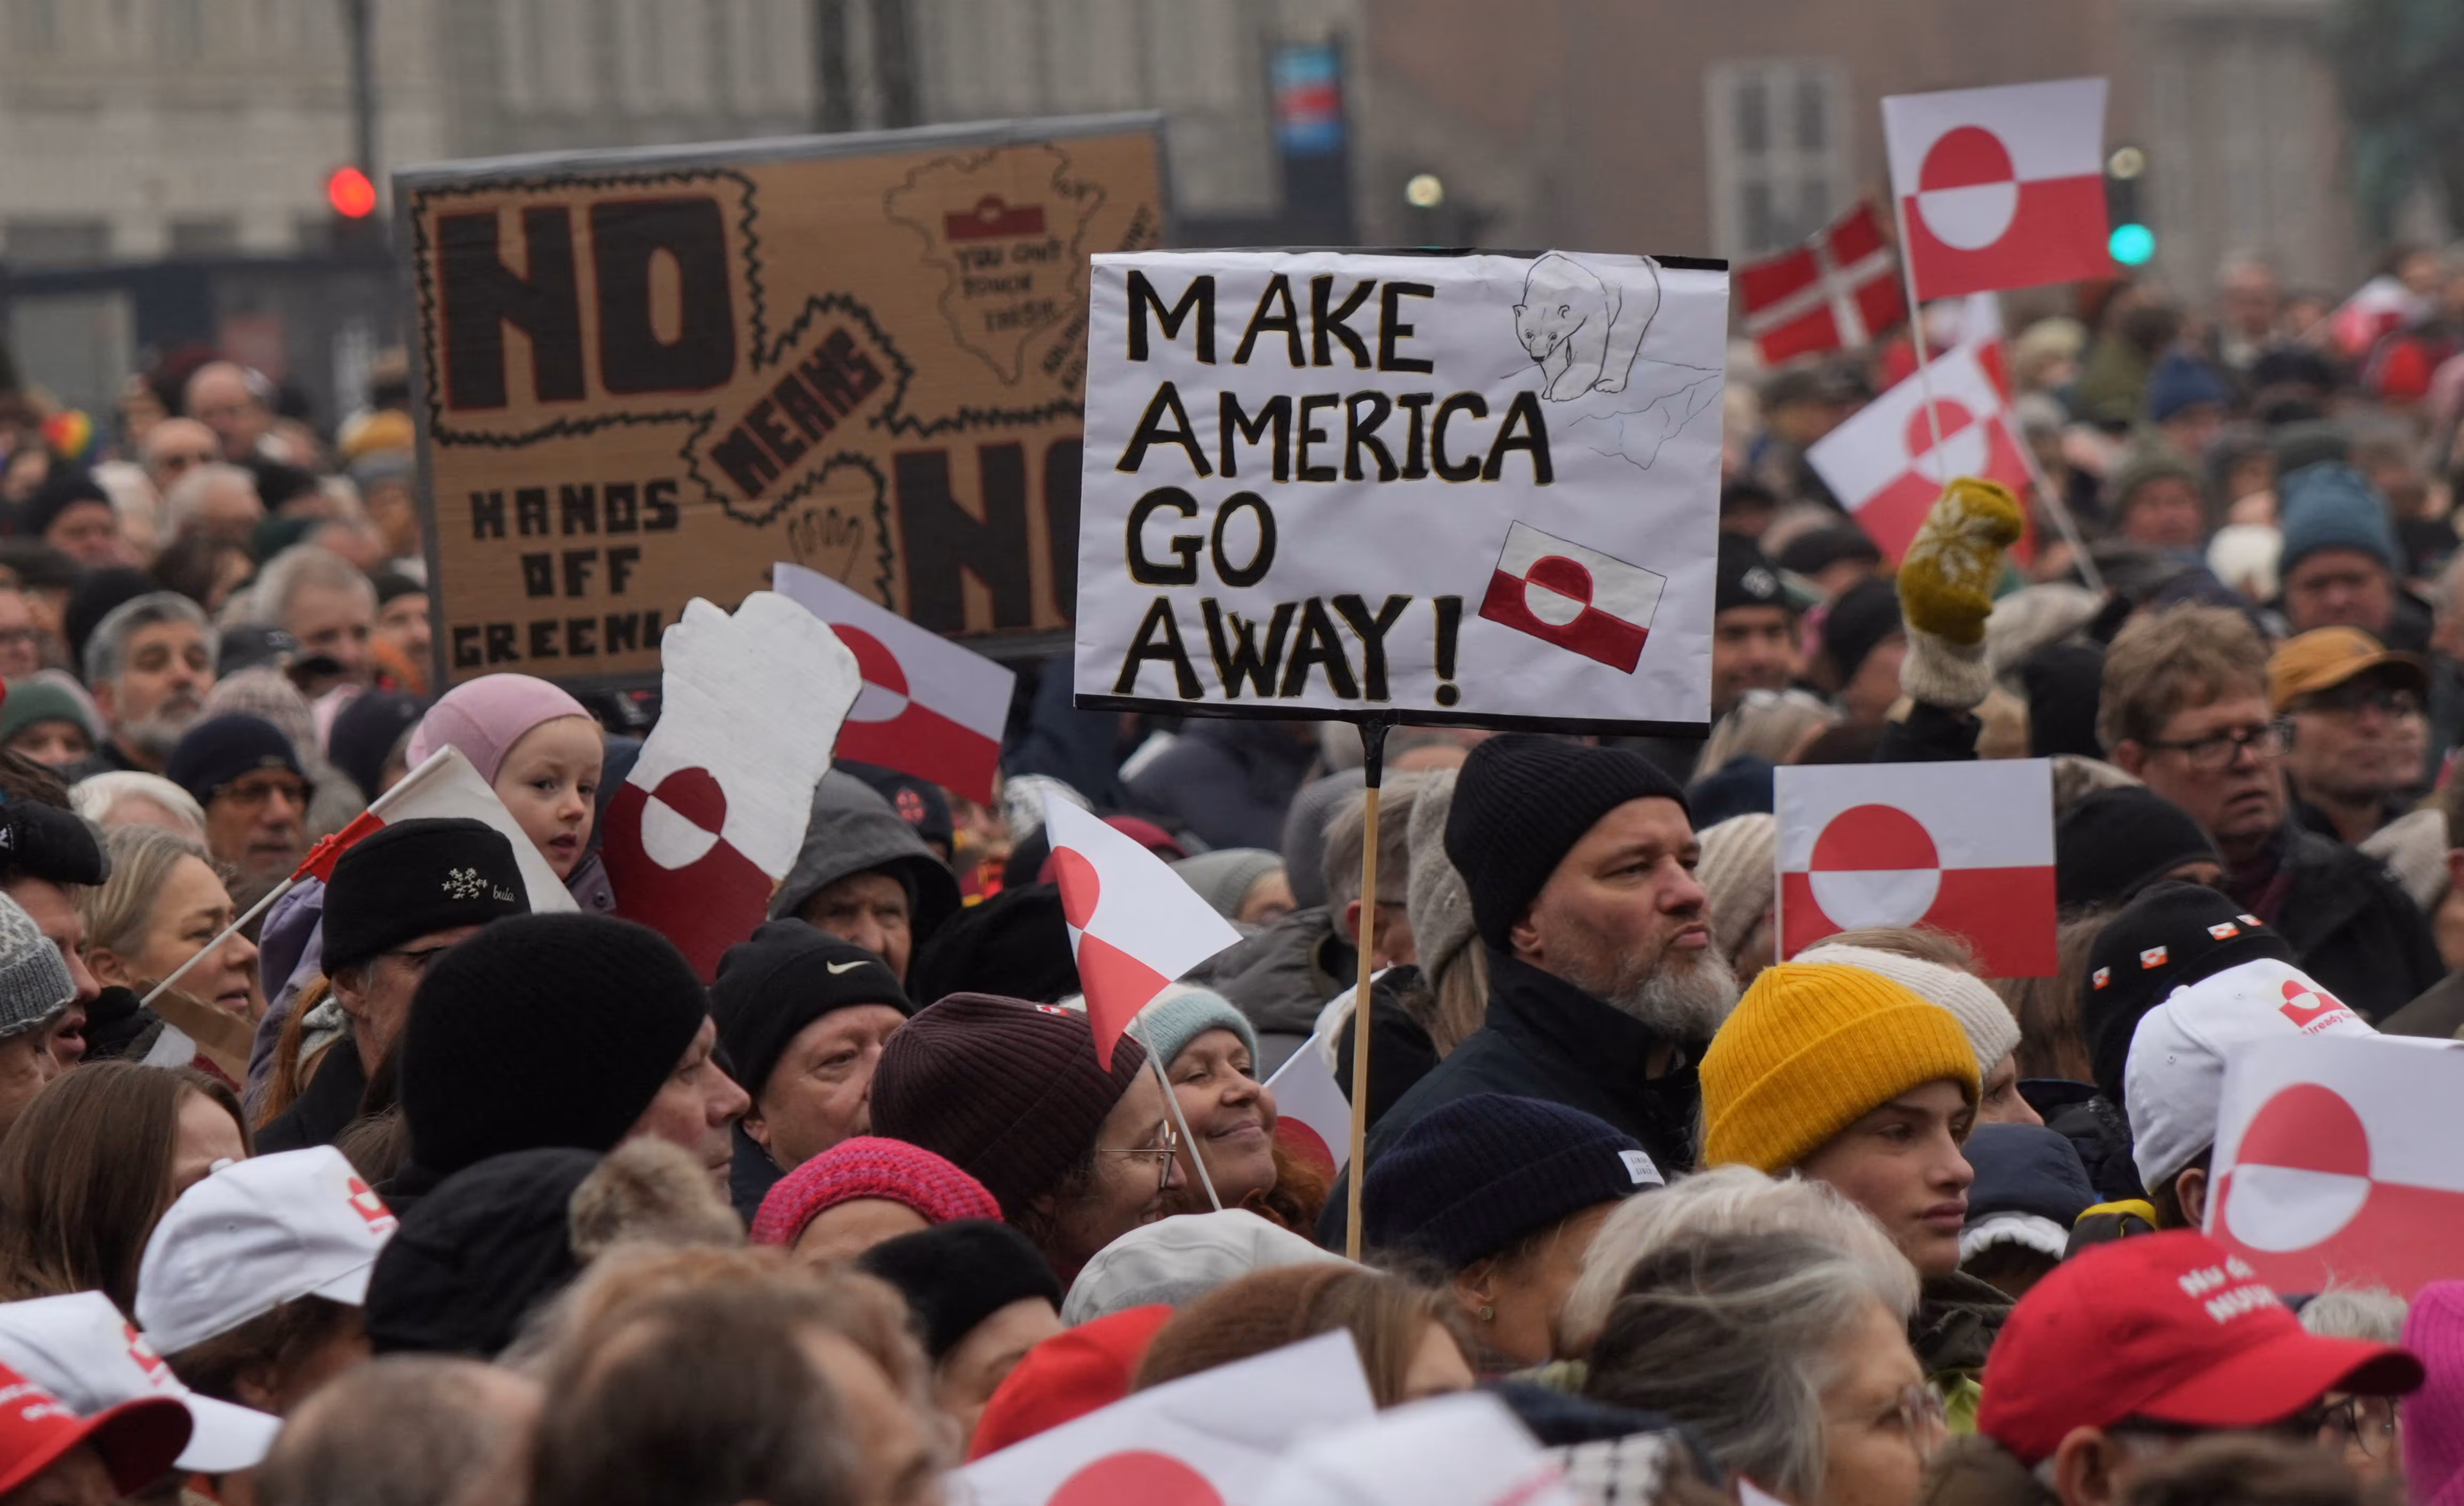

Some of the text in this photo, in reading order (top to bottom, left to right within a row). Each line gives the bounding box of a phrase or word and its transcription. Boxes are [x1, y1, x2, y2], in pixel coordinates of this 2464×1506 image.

[435, 194, 736, 412] NO
[1126, 270, 1435, 373] MAKE
[710, 327, 884, 498] MEANS
[1115, 381, 1554, 486] AMERICA
[471, 478, 680, 540] HANDS
[893, 439, 1083, 635] N
[1124, 486, 1277, 587] GO
[521, 546, 641, 598] OFF
[452, 611, 663, 669] GREENL
[1111, 595, 1464, 707] AWAY!
